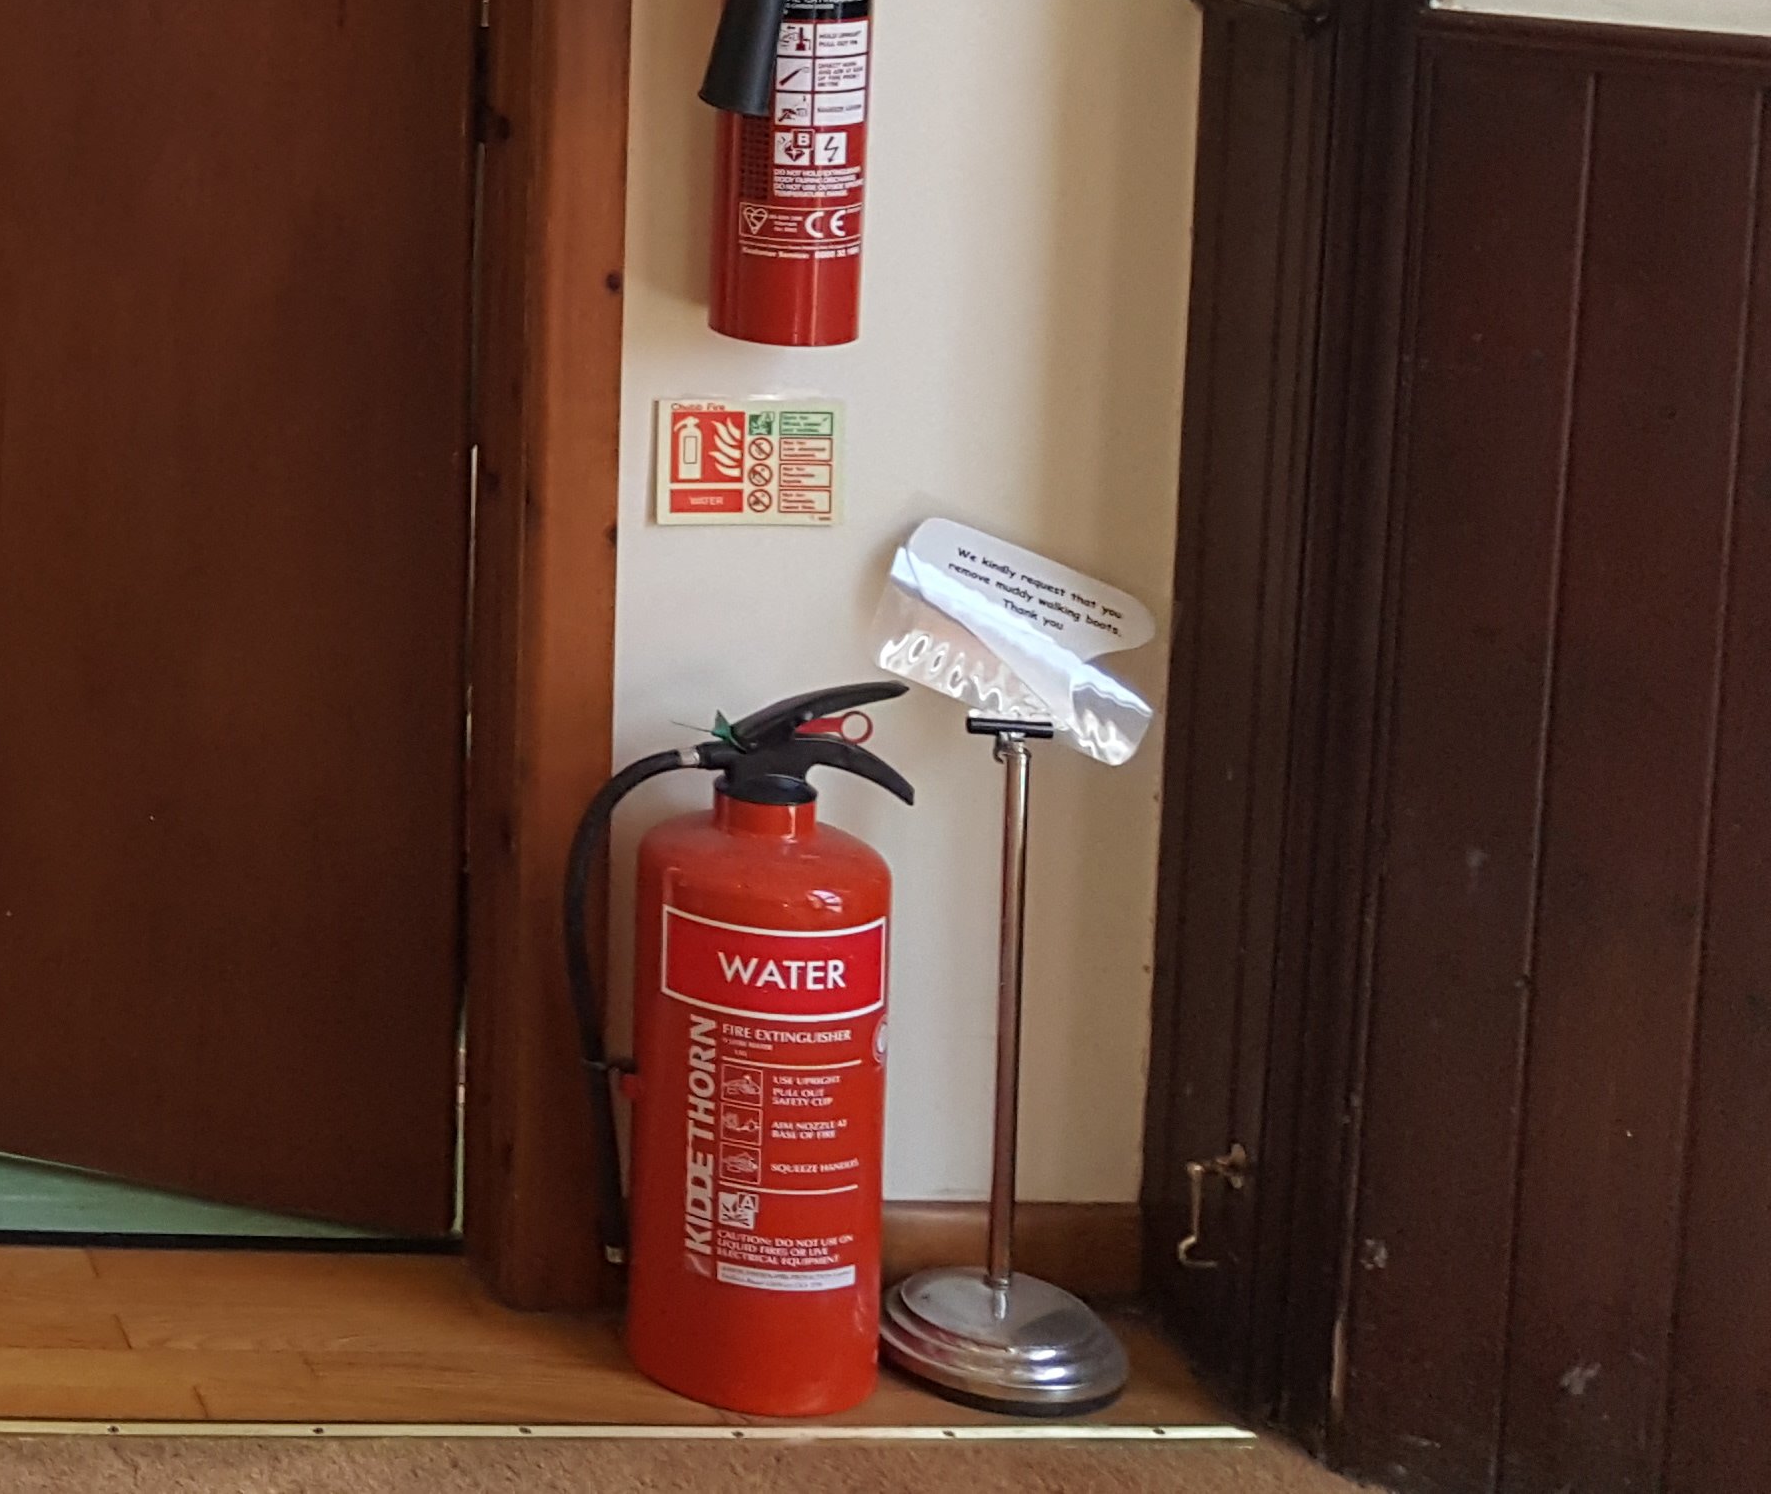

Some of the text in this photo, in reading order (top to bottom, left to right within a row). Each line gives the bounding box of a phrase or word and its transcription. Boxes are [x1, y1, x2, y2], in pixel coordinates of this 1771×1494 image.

[689, 496, 723, 506] WATER
[948, 562, 1121, 637] remove muddy walking boots.
[958, 547, 1123, 620] We kindly request that you
[1003, 599, 1063, 631] Thank you
[718, 951, 846, 990] WATER
[722, 1024, 851, 1043] FIRE EXTINGUISHER
[685, 1014, 717, 1255] KIDDE THORN
[771, 1163, 817, 1173] SQUEEZE
[717, 1230, 772, 1246] CAUTION:
